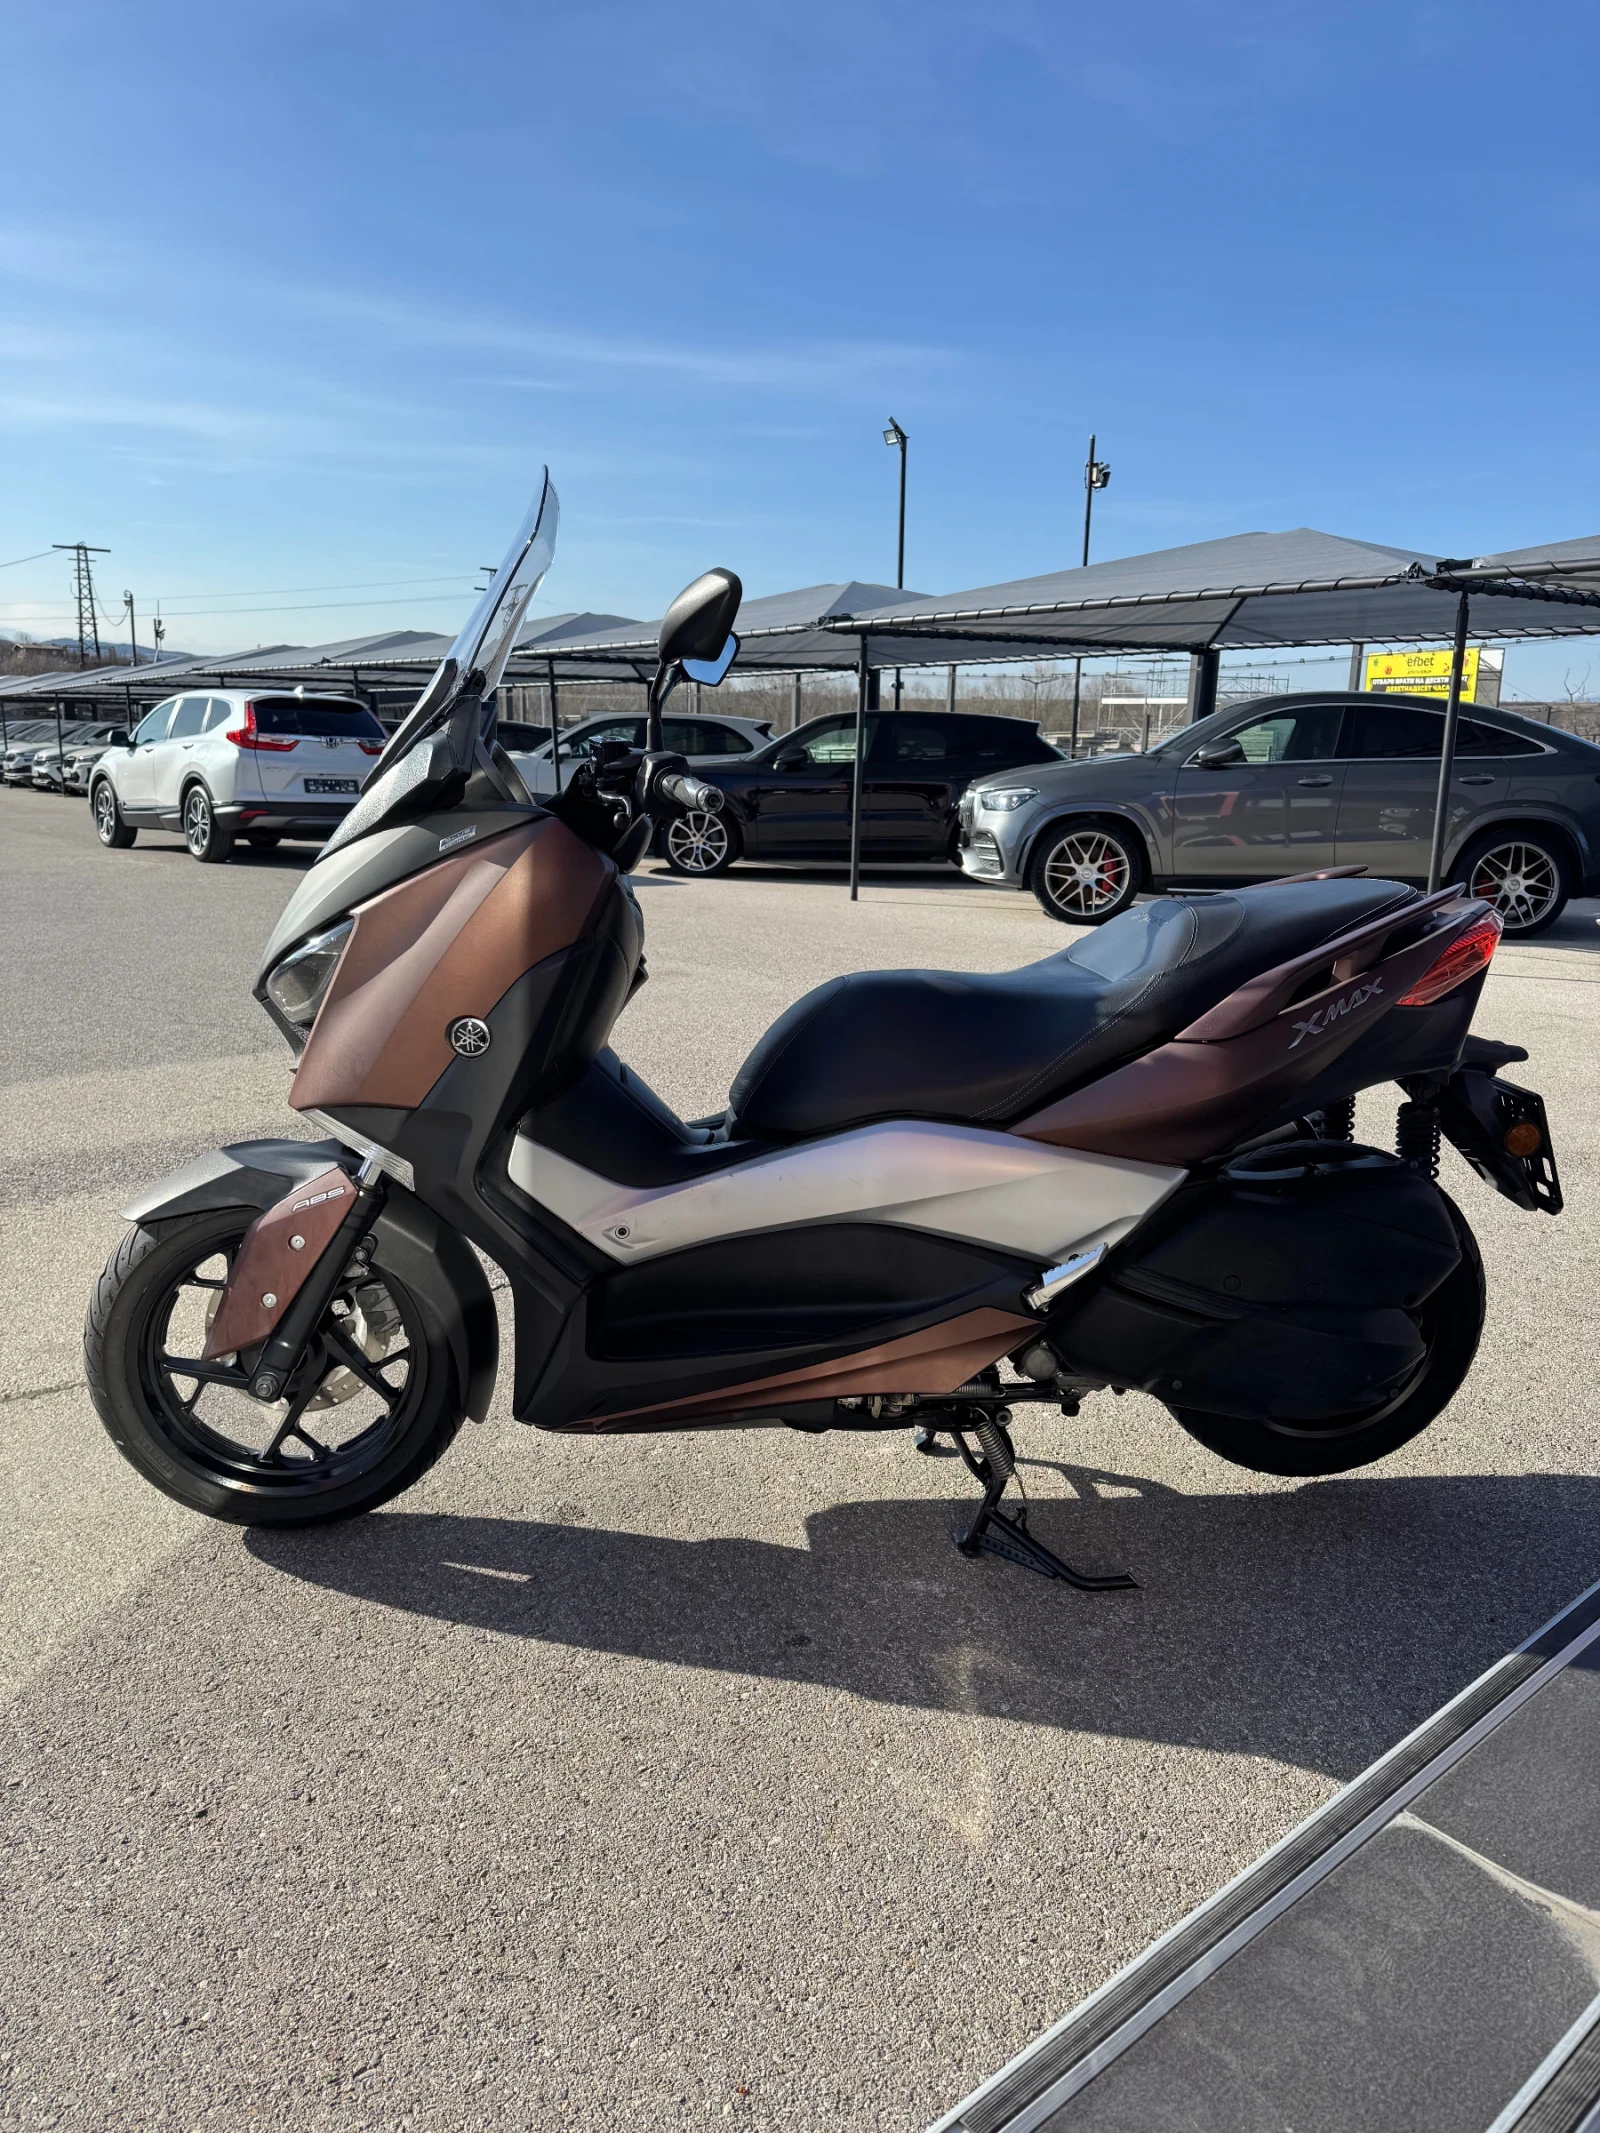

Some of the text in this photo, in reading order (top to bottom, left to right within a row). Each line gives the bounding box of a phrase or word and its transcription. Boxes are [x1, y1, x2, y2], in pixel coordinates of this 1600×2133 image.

[1406, 657, 1435, 667] efbet
[1288, 976, 1384, 1050] XMAX
[292, 1186, 345, 1212] ABS
